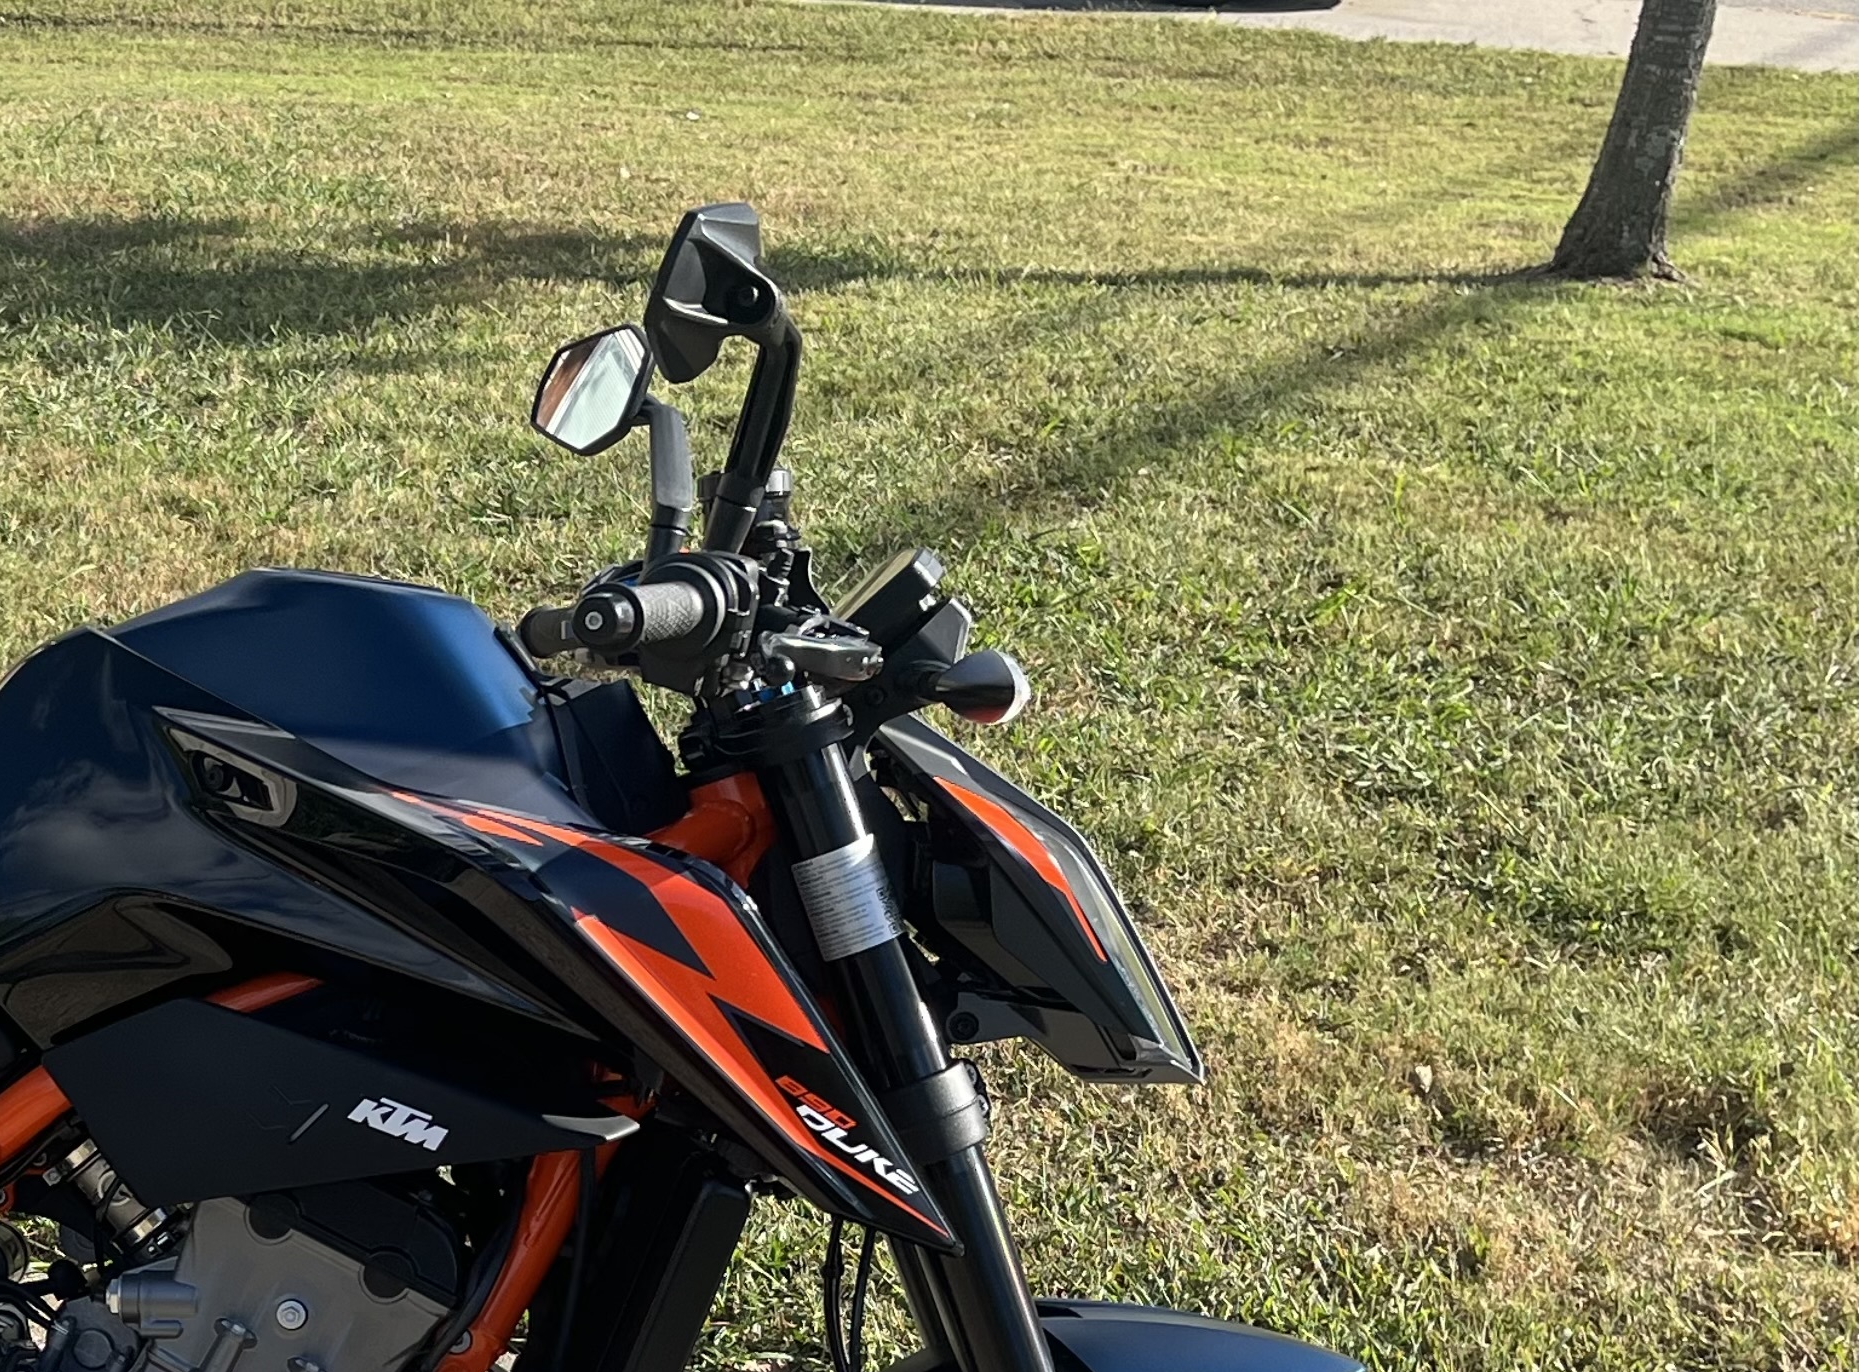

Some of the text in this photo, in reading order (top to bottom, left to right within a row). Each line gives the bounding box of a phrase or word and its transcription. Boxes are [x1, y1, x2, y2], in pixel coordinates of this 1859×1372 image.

[346, 1097, 449, 1151] KTM
[776, 1076, 857, 1130] 890
[796, 1105, 919, 1195] DUKE
